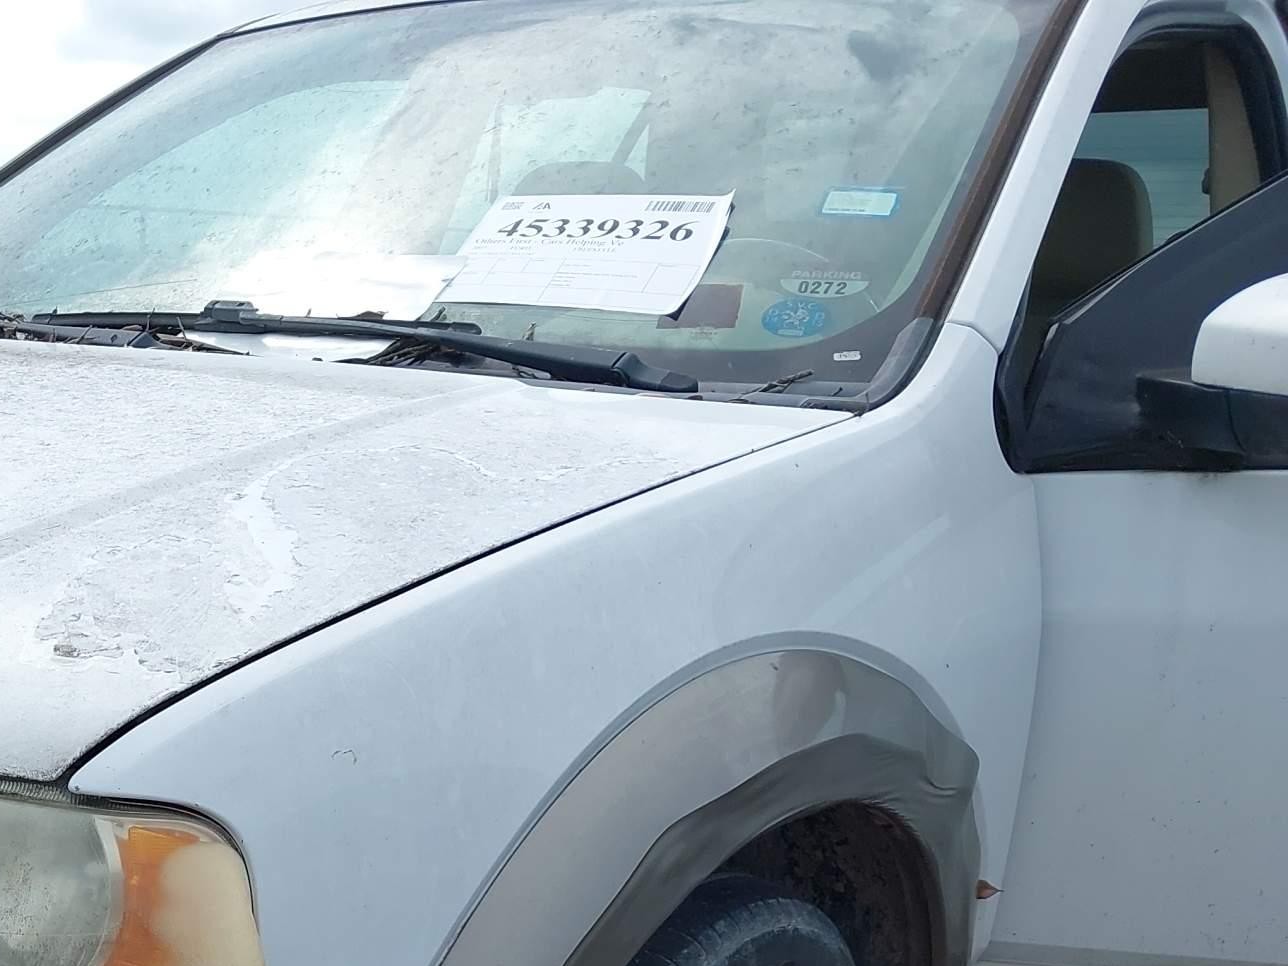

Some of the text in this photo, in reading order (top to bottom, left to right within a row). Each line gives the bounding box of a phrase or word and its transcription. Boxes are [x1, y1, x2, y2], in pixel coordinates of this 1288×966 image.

[497, 218, 700, 242] 45339326
[791, 270, 862, 279] PARKING
[798, 281, 848, 295] 0272
